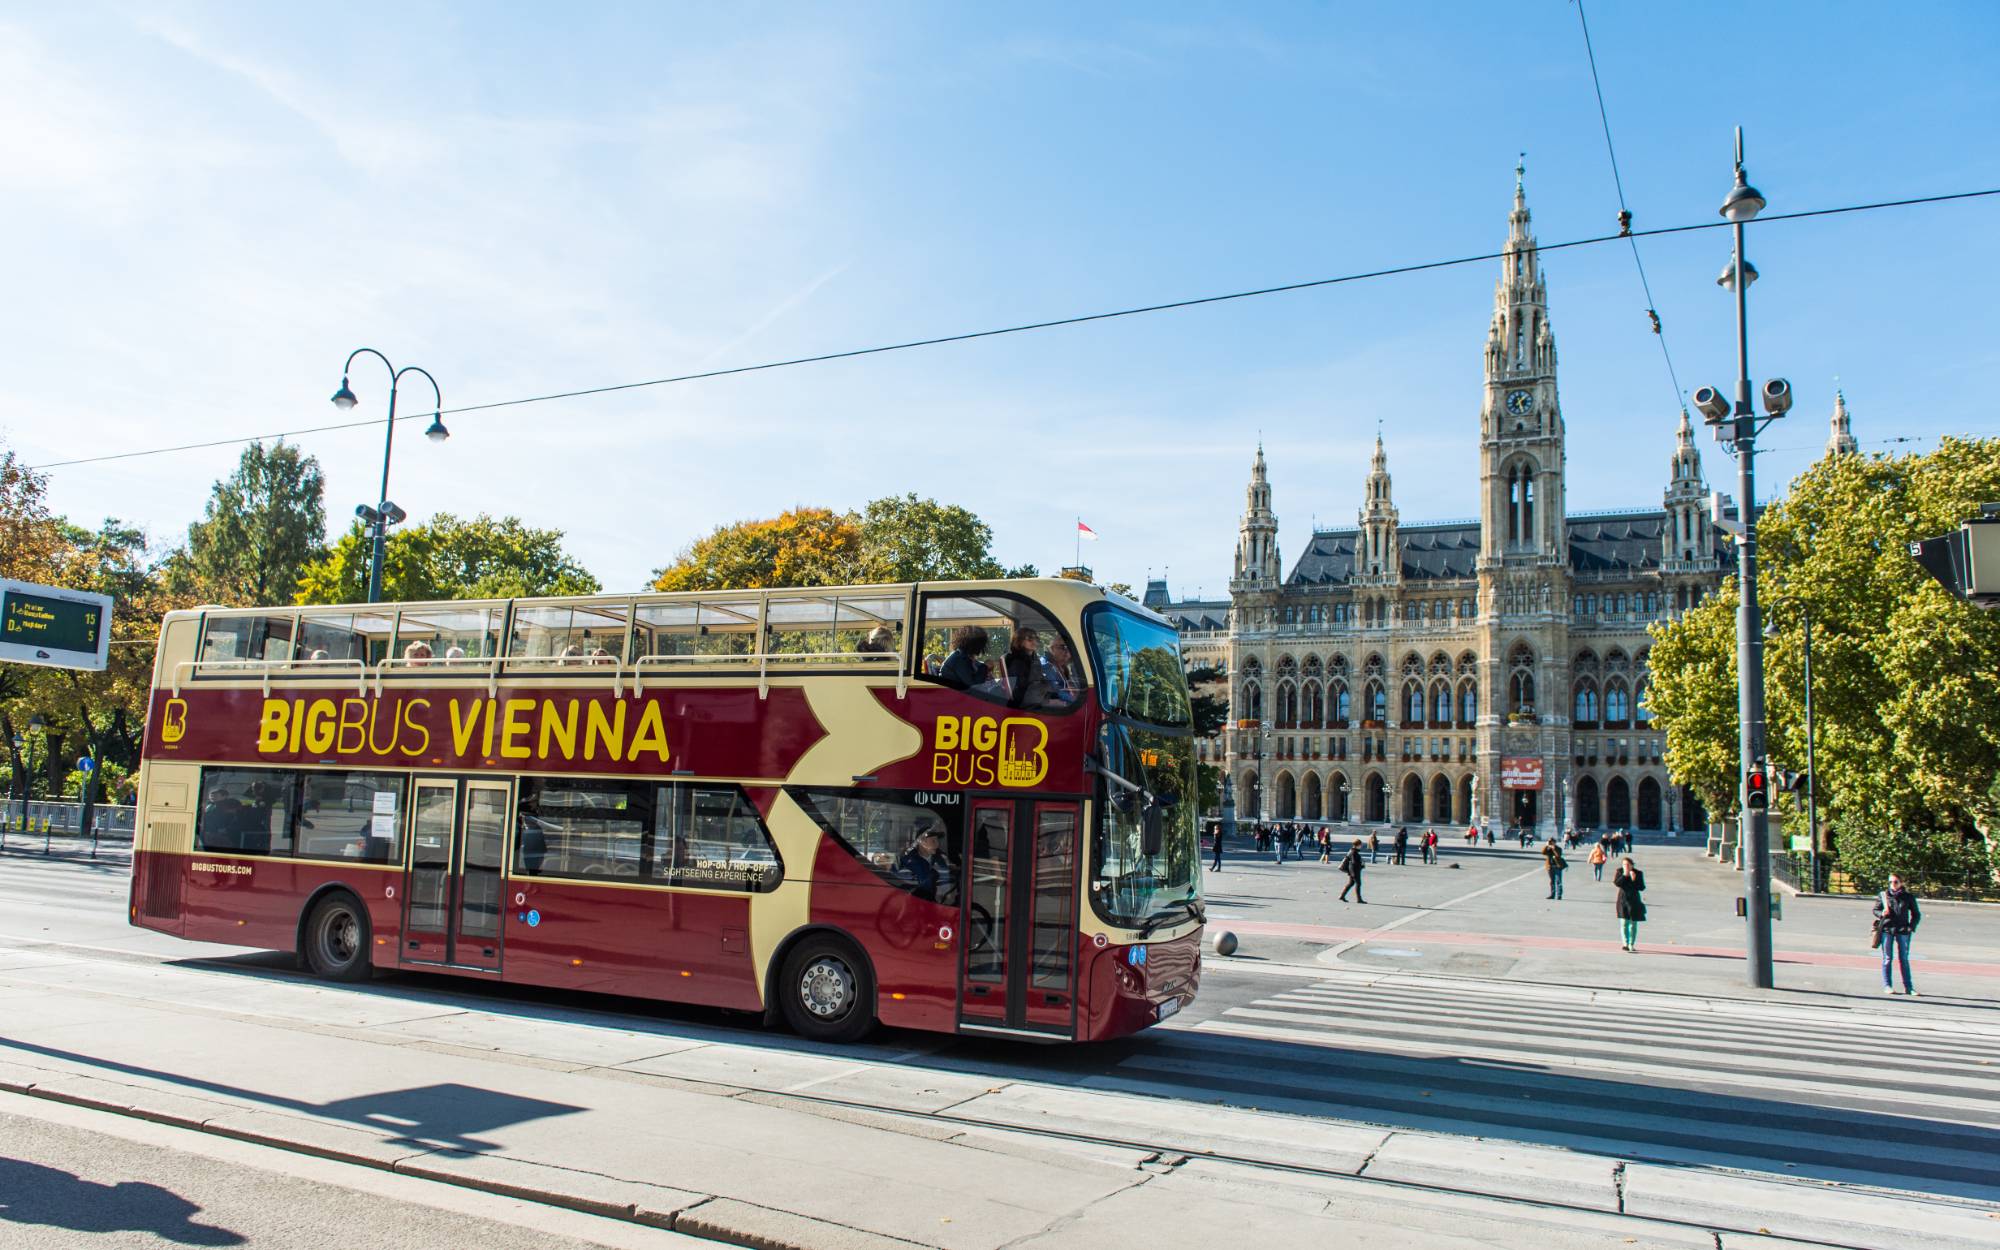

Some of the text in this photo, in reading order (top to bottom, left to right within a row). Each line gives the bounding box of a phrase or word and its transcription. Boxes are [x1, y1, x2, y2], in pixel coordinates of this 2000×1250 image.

[1911, 543, 1921, 555] 5
[10, 602, 16, 614] 1
[7, 619, 15, 631] D
[85, 613, 96, 625] 15
[87, 630, 95, 642] 5
[449, 698, 670, 762] VIENNA
[935, 715, 998, 752] BIG
[932, 752, 995, 786] BUS
[191, 862, 252, 876] BIGBUSTOURS.COM
[696, 859, 727, 871] HOP-ON
[734, 862, 769, 873] HOP-OFF
[663, 866, 764, 882] SIGHTSEEING EXPERIENCE
